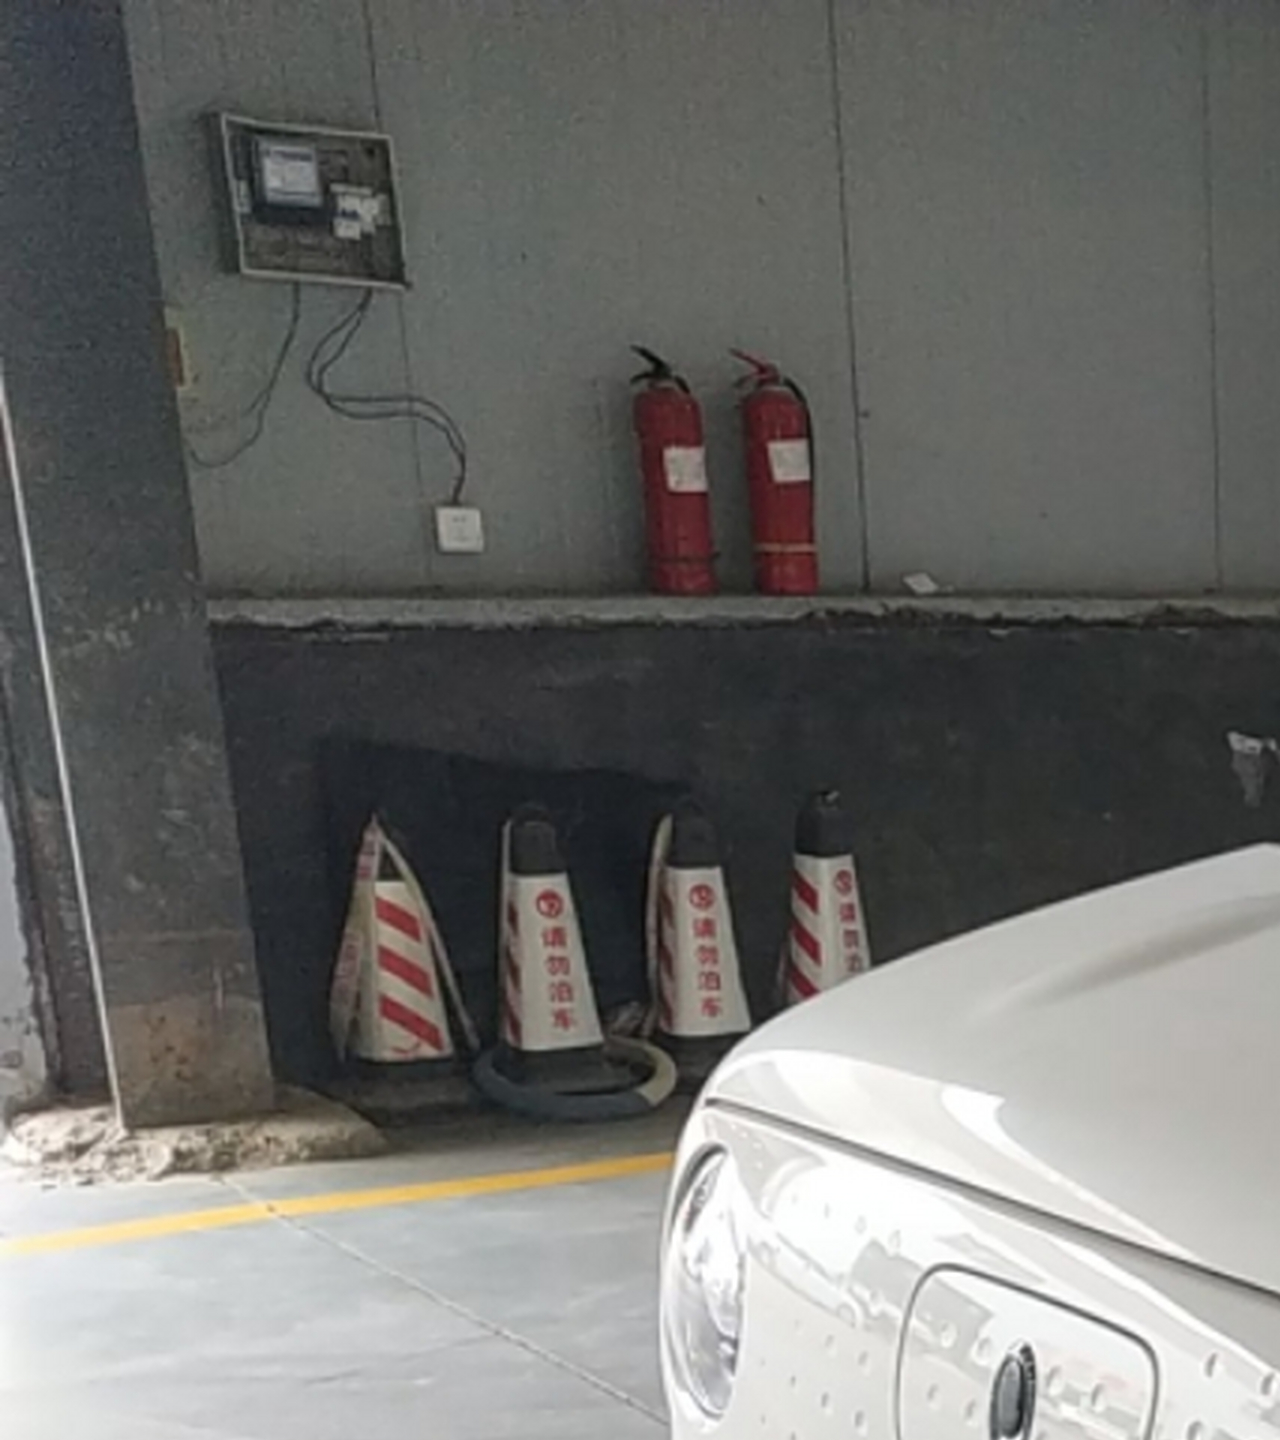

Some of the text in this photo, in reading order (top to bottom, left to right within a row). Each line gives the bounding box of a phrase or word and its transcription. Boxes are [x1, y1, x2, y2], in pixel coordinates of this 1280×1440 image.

[542, 926, 576, 1031] 请勿泊车
[692, 917, 722, 1018] 请勿泊车
